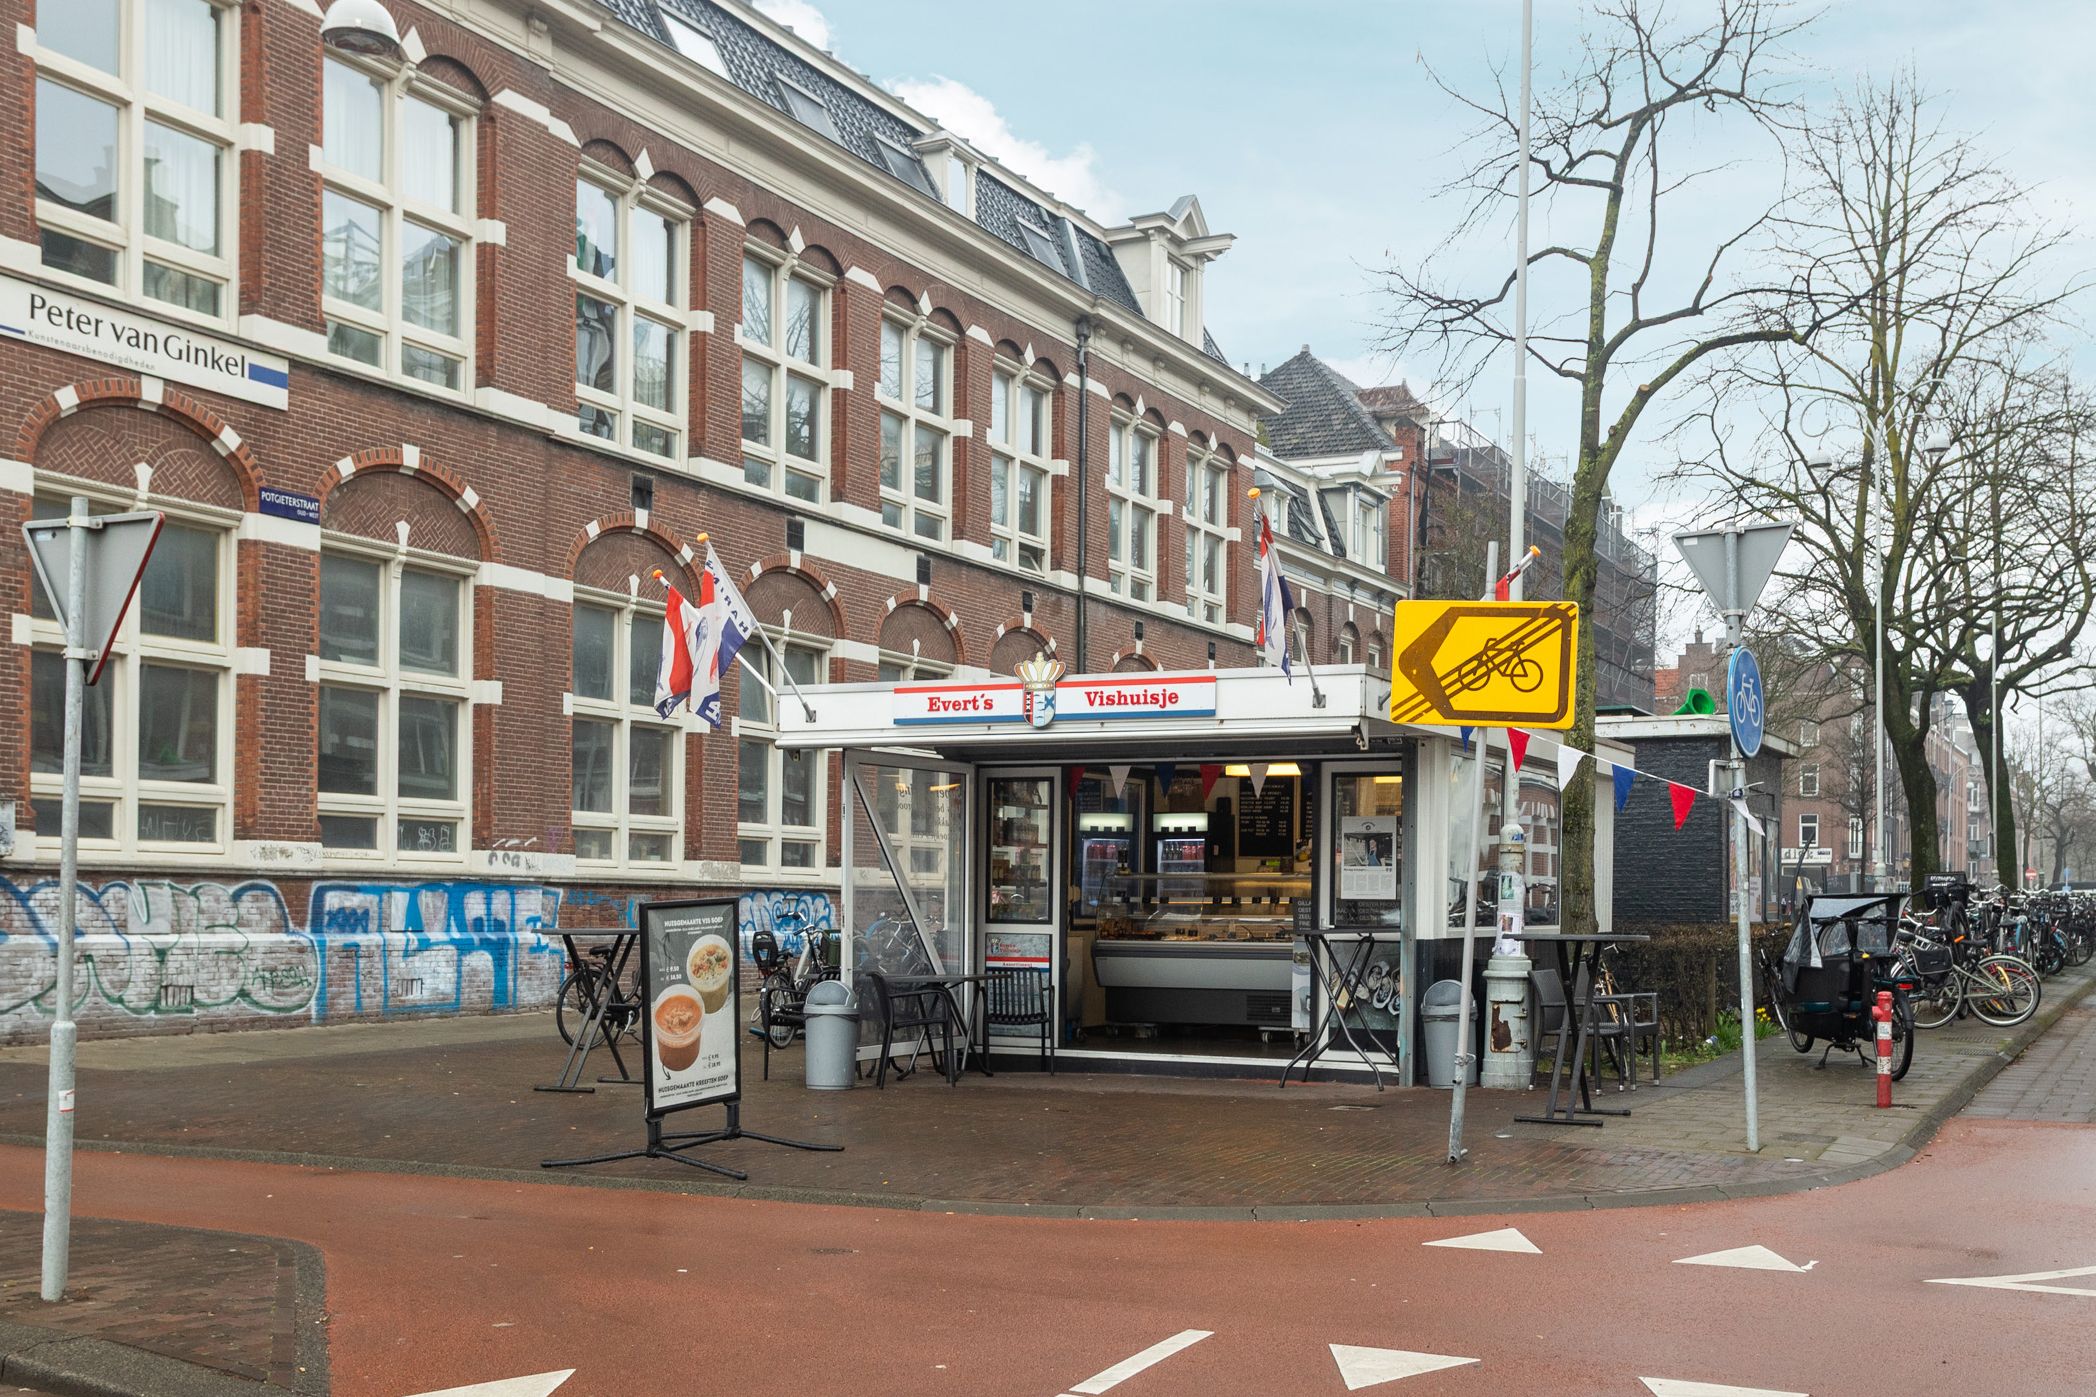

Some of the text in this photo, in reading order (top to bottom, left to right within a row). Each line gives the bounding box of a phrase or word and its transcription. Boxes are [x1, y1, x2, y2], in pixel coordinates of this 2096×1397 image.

[29, 293, 246, 379] Peter van Ginkel
[27, 328, 156, 371] Kunstenaarsbenodigdheden
[261, 491, 319, 511] POTGIETERSTRAAT
[927, 690, 1179, 712] Evert's Vishuisje
[664, 918, 701, 927] HUISGEMAAKTE
[711, 916, 723, 924] SOEP
[658, 1080, 695, 1094] HUISGEMAAKTE
